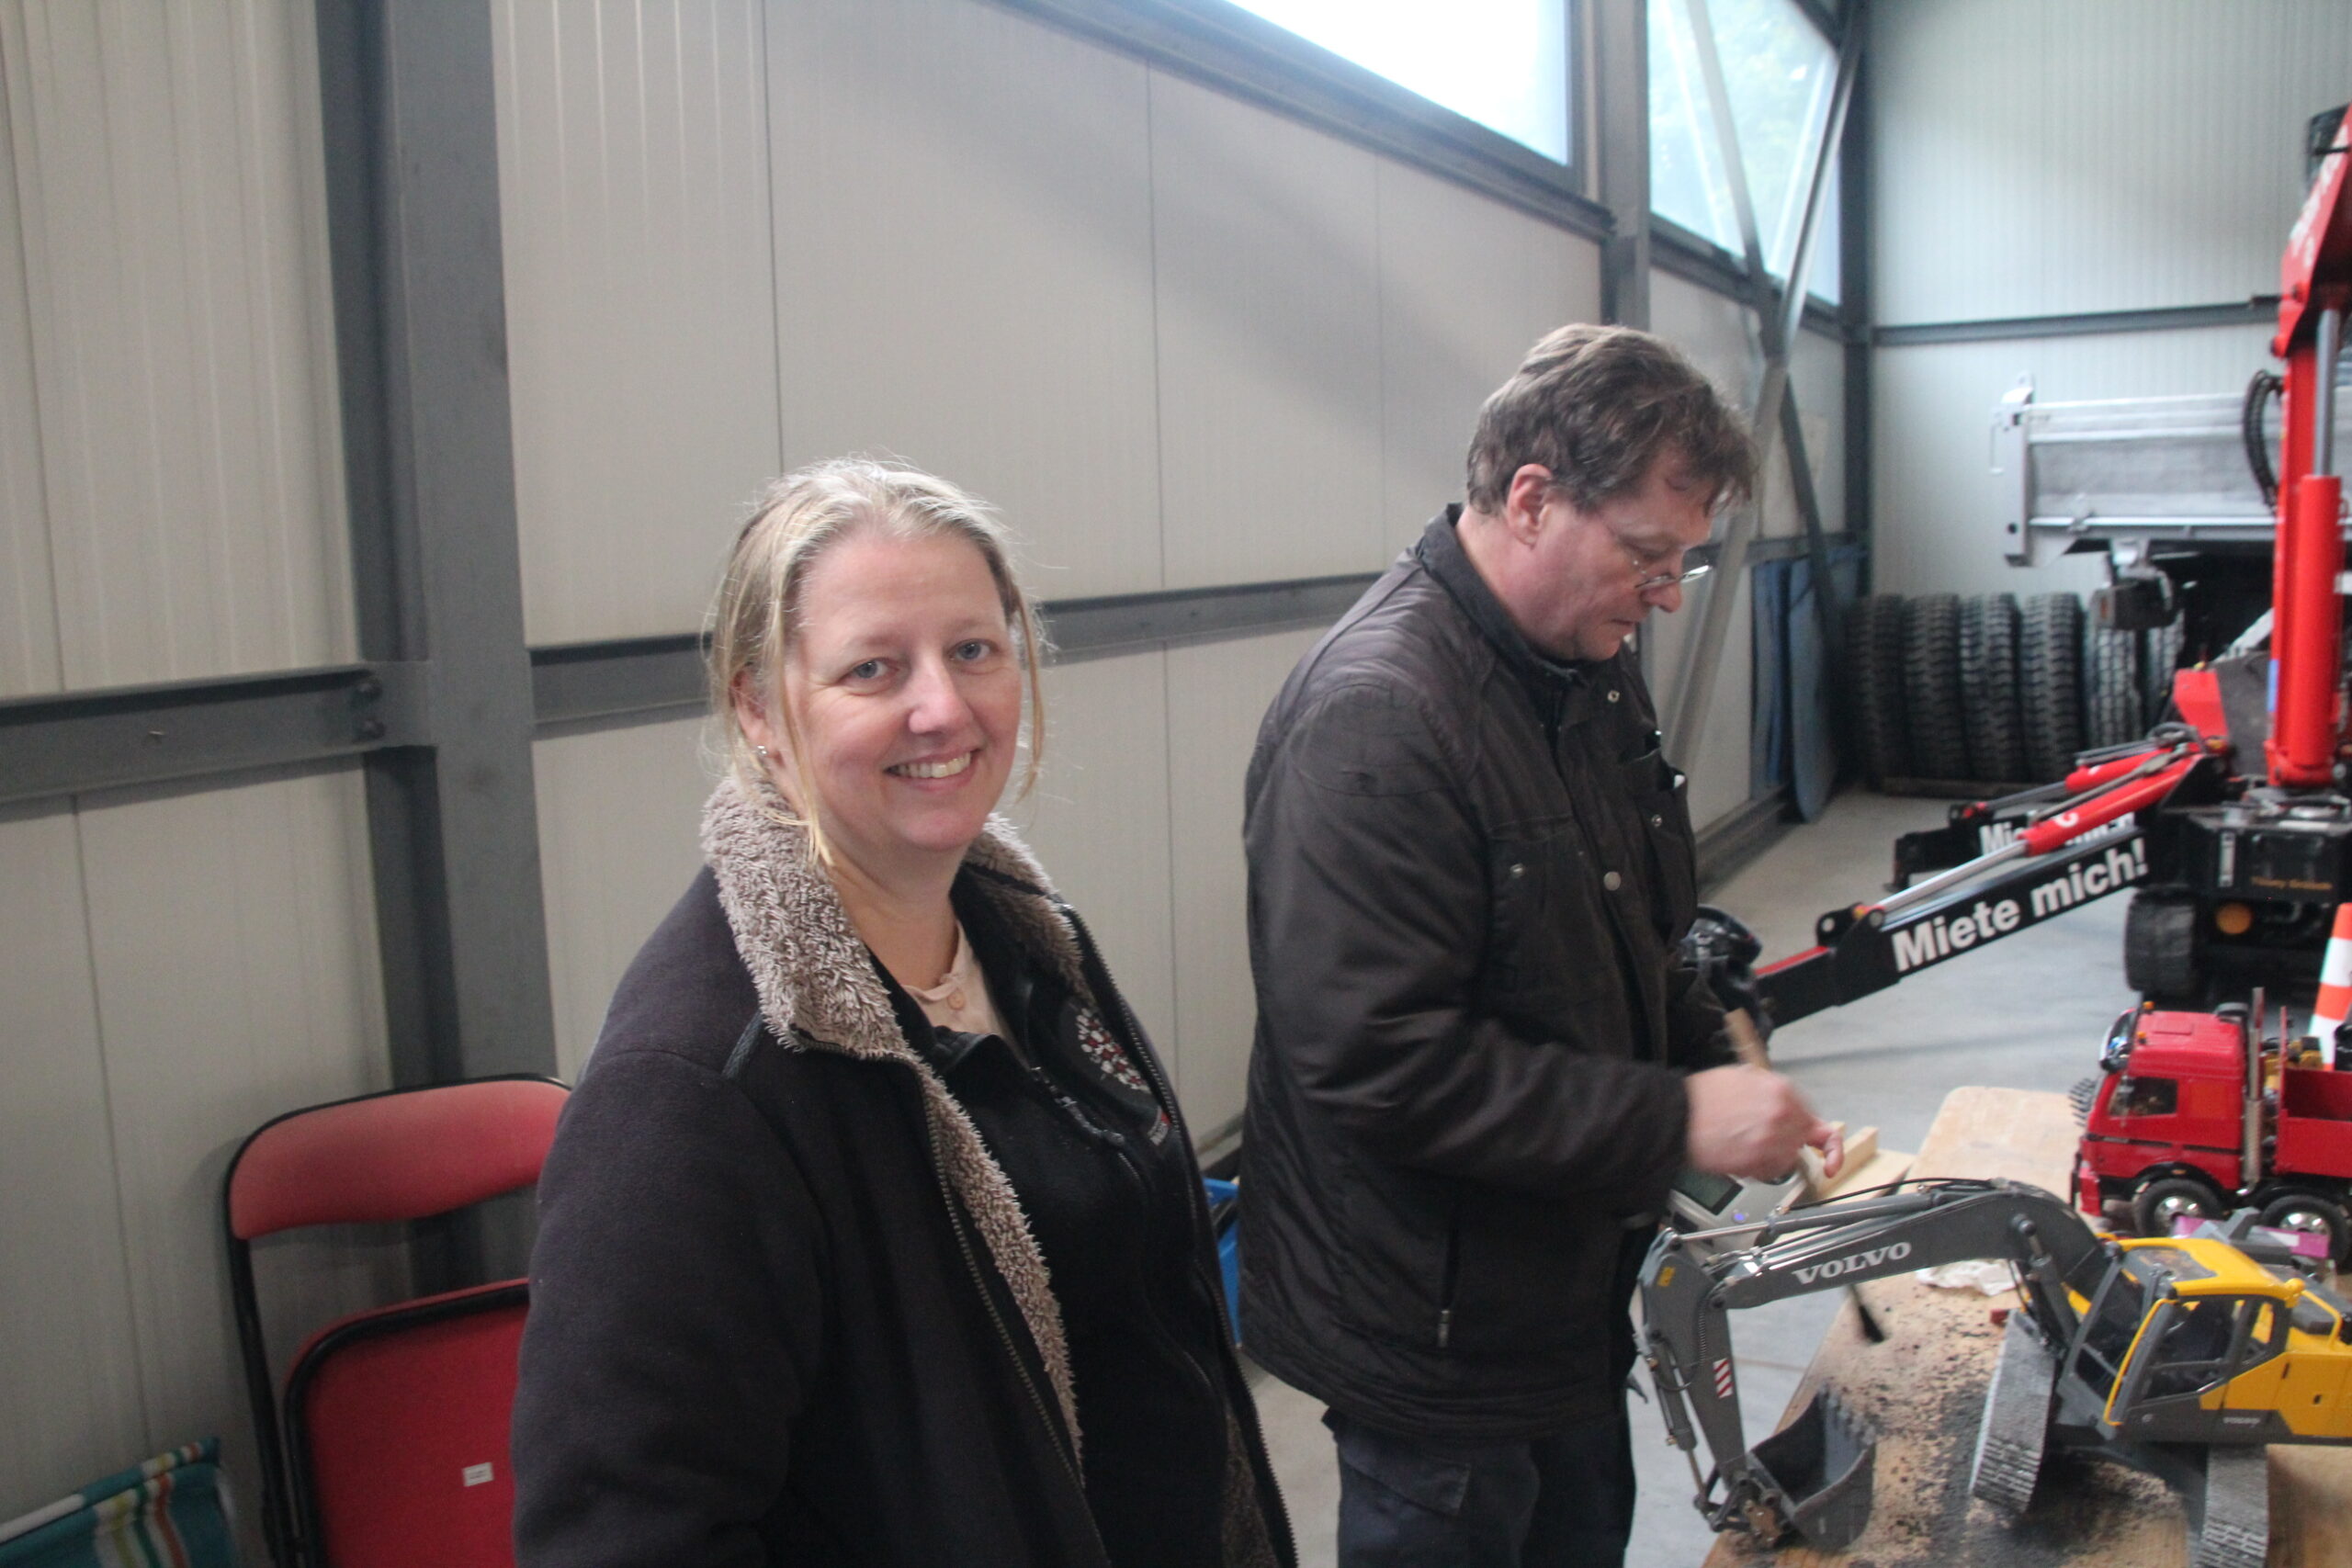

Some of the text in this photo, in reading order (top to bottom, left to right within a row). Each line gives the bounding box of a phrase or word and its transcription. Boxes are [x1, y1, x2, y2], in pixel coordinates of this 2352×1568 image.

[1892, 899, 2020, 973] Miete
[2030, 838, 2149, 918] mich!
[1792, 1242, 1912, 1285] VOLVO
